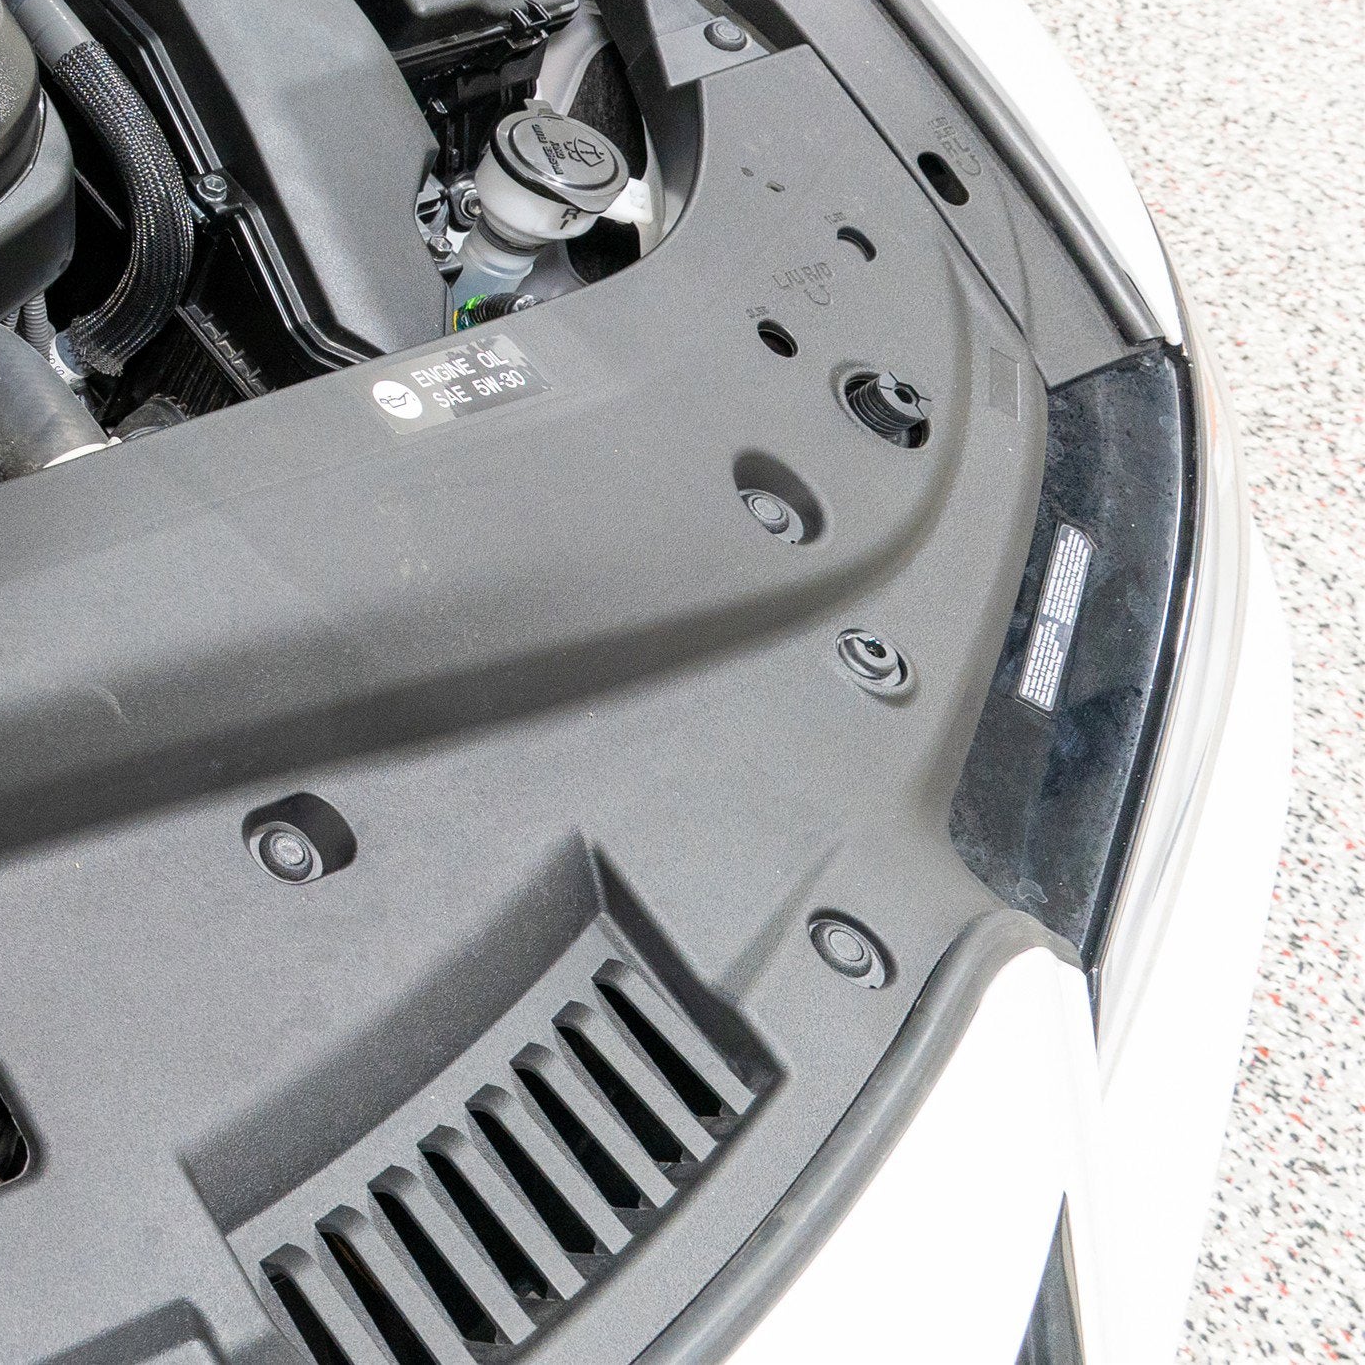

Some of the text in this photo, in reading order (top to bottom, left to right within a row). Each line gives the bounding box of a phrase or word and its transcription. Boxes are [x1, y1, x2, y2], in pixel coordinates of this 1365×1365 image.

[410, 349, 510, 388] ENGINE OIL
[432, 370, 526, 409] SAE 5W-30
